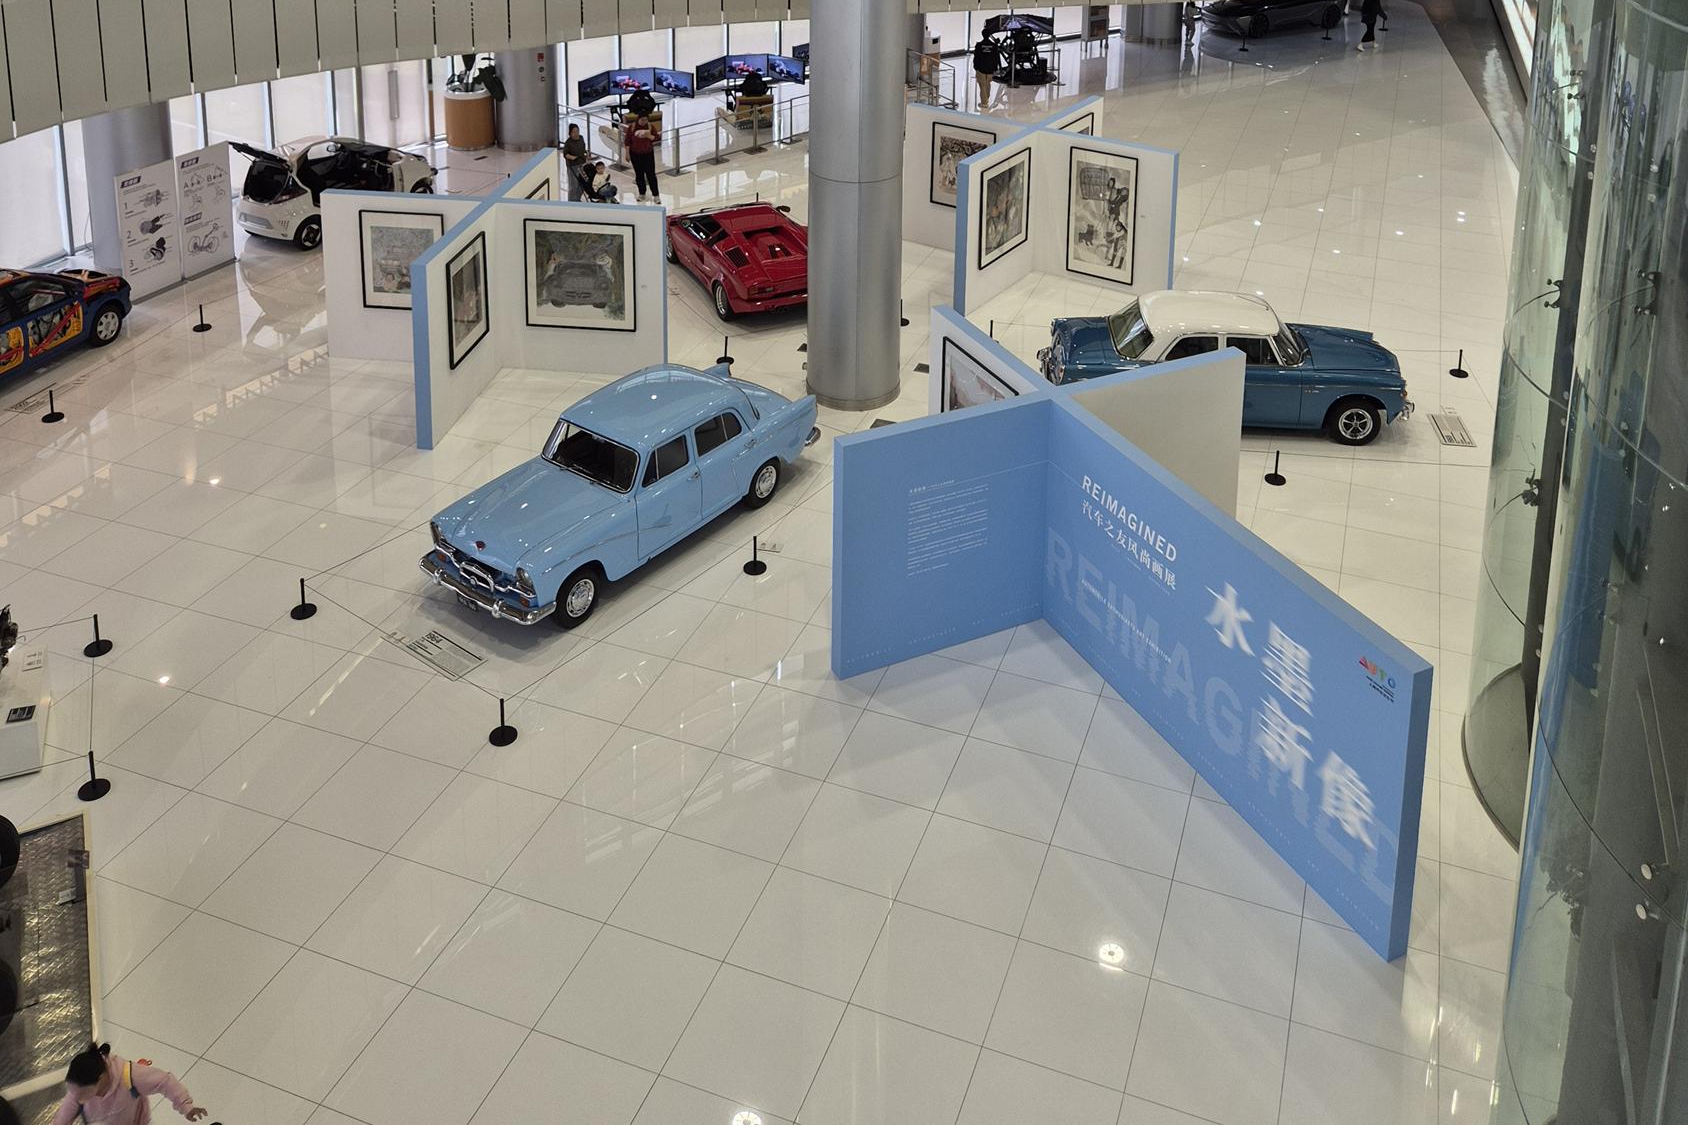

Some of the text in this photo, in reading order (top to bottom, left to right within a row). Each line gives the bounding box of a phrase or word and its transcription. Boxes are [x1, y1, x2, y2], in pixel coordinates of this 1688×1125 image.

[1081, 474, 1177, 562] REIMAGINED
[1082, 499, 1177, 591] 汽车之友风尚画展
